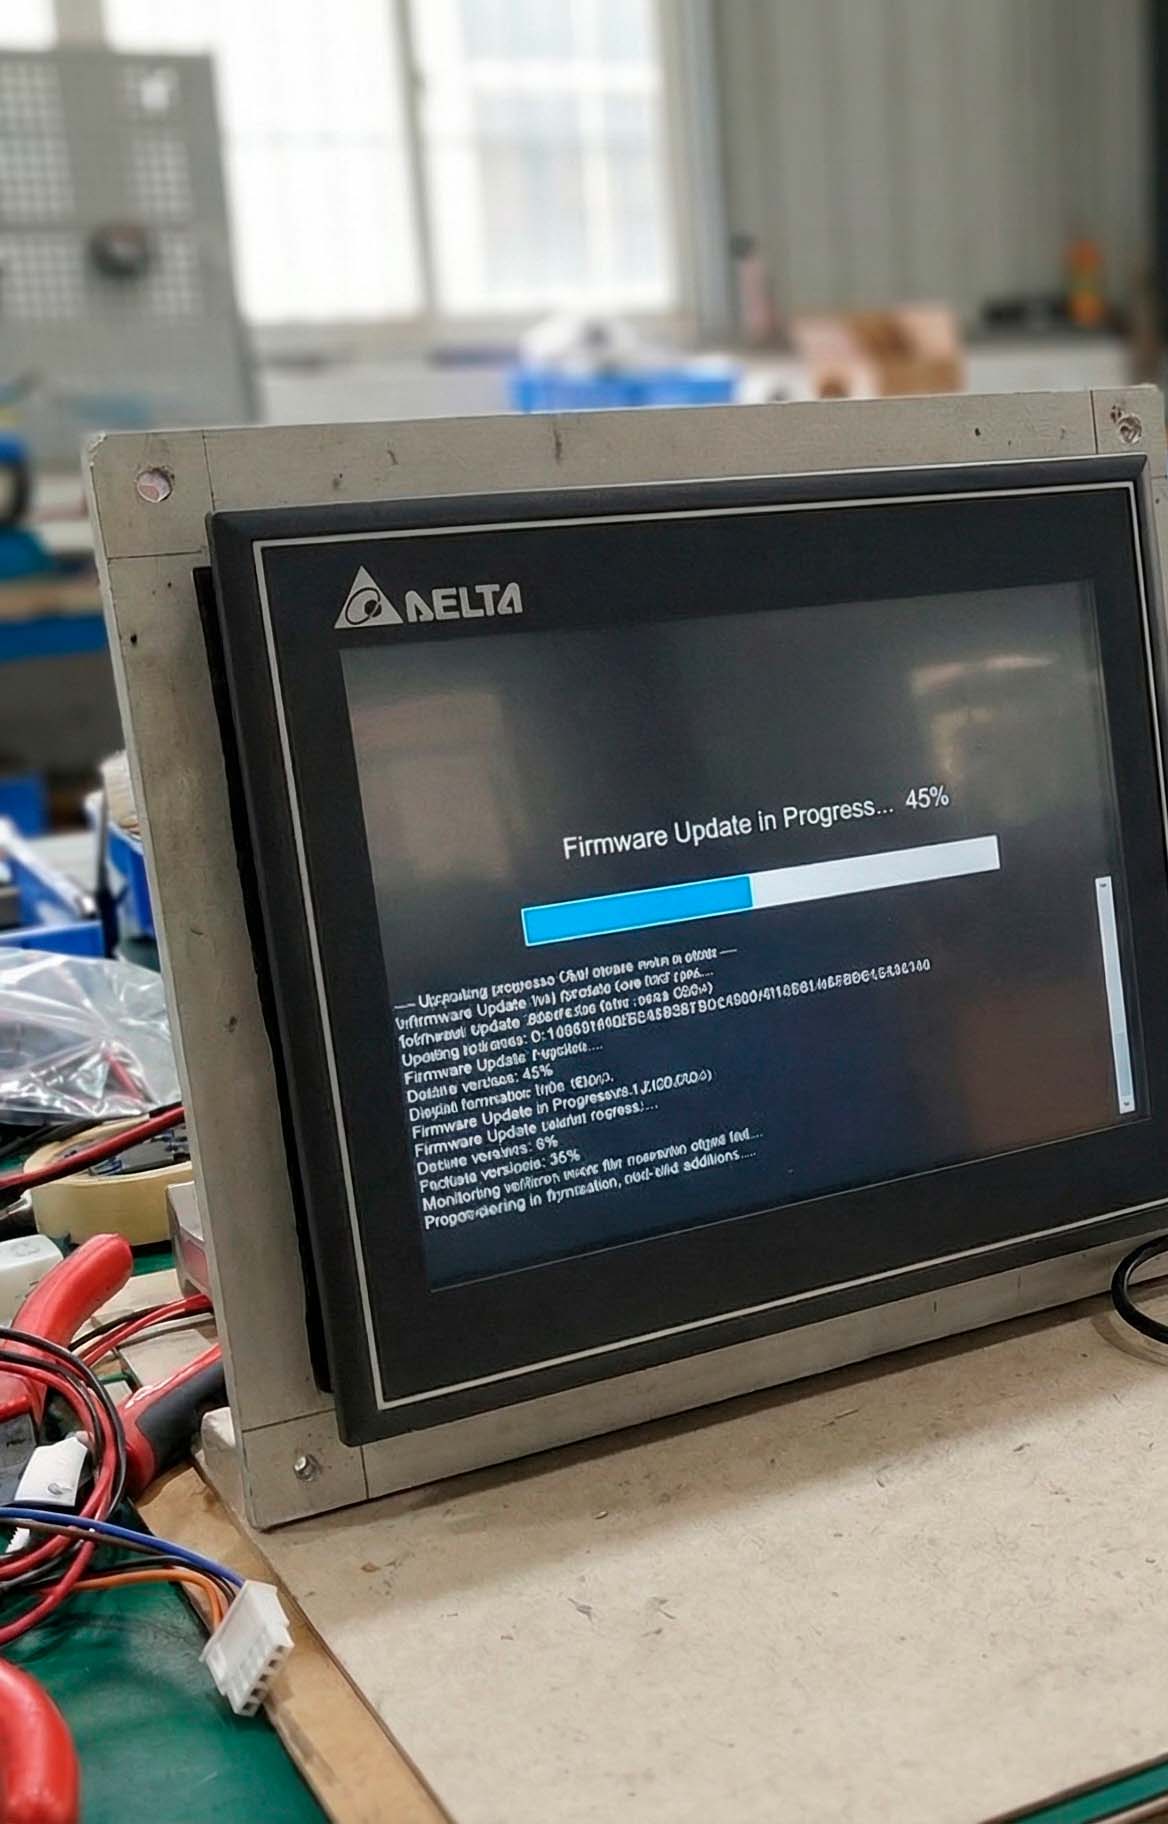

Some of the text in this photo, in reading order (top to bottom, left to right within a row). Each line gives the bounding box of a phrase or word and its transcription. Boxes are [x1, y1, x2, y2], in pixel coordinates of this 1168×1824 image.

[405, 582, 523, 623] DELTA
[563, 785, 949, 860] Firmware Update in Progress... 45%
[412, 1117, 478, 1140] Firmware
[481, 1107, 533, 1126] Update
[536, 1101, 549, 1115] in
[414, 1134, 482, 1157] Firmware
[487, 1124, 537, 1144] Update
